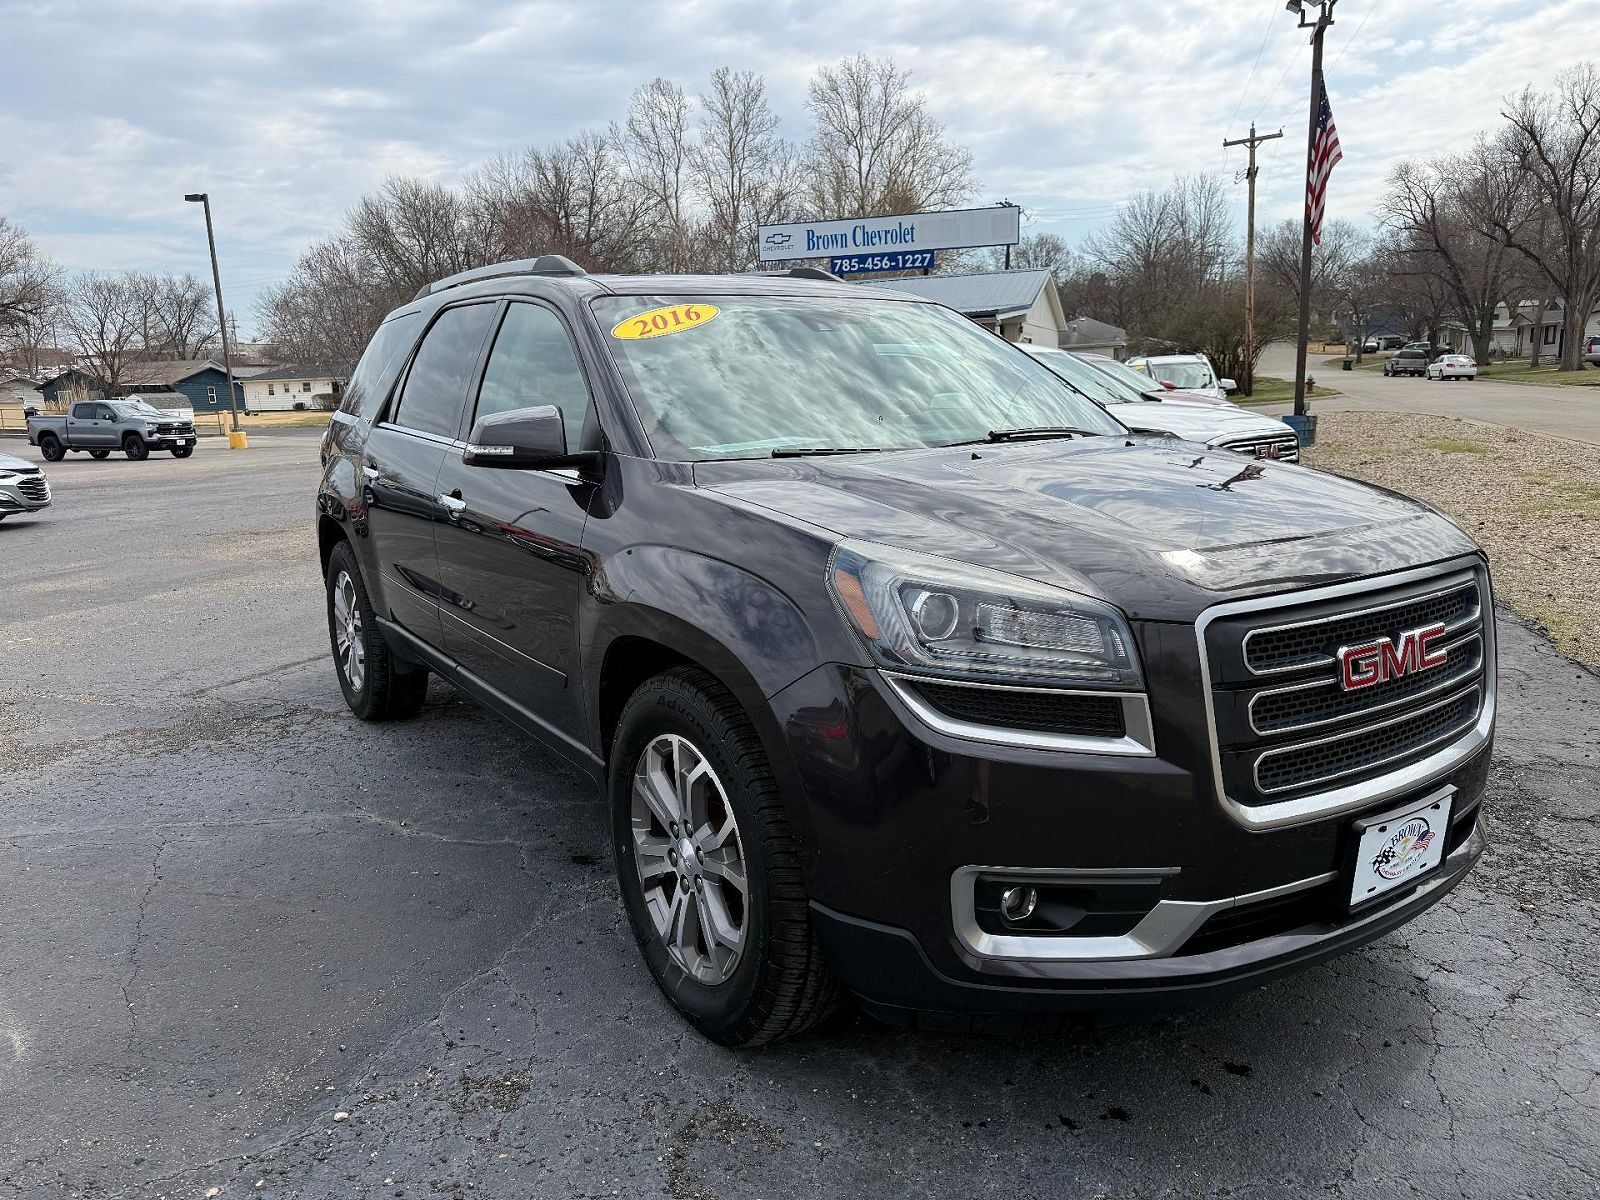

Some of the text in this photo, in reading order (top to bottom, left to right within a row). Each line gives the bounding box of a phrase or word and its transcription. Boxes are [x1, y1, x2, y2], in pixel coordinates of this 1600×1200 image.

[762, 244, 795, 252] CHEVROLET
[806, 222, 916, 251] Brown Chevrolet
[833, 253, 932, 273] 785-456-1227
[633, 305, 701, 337] 2016
[1337, 622, 1448, 691] GMC
